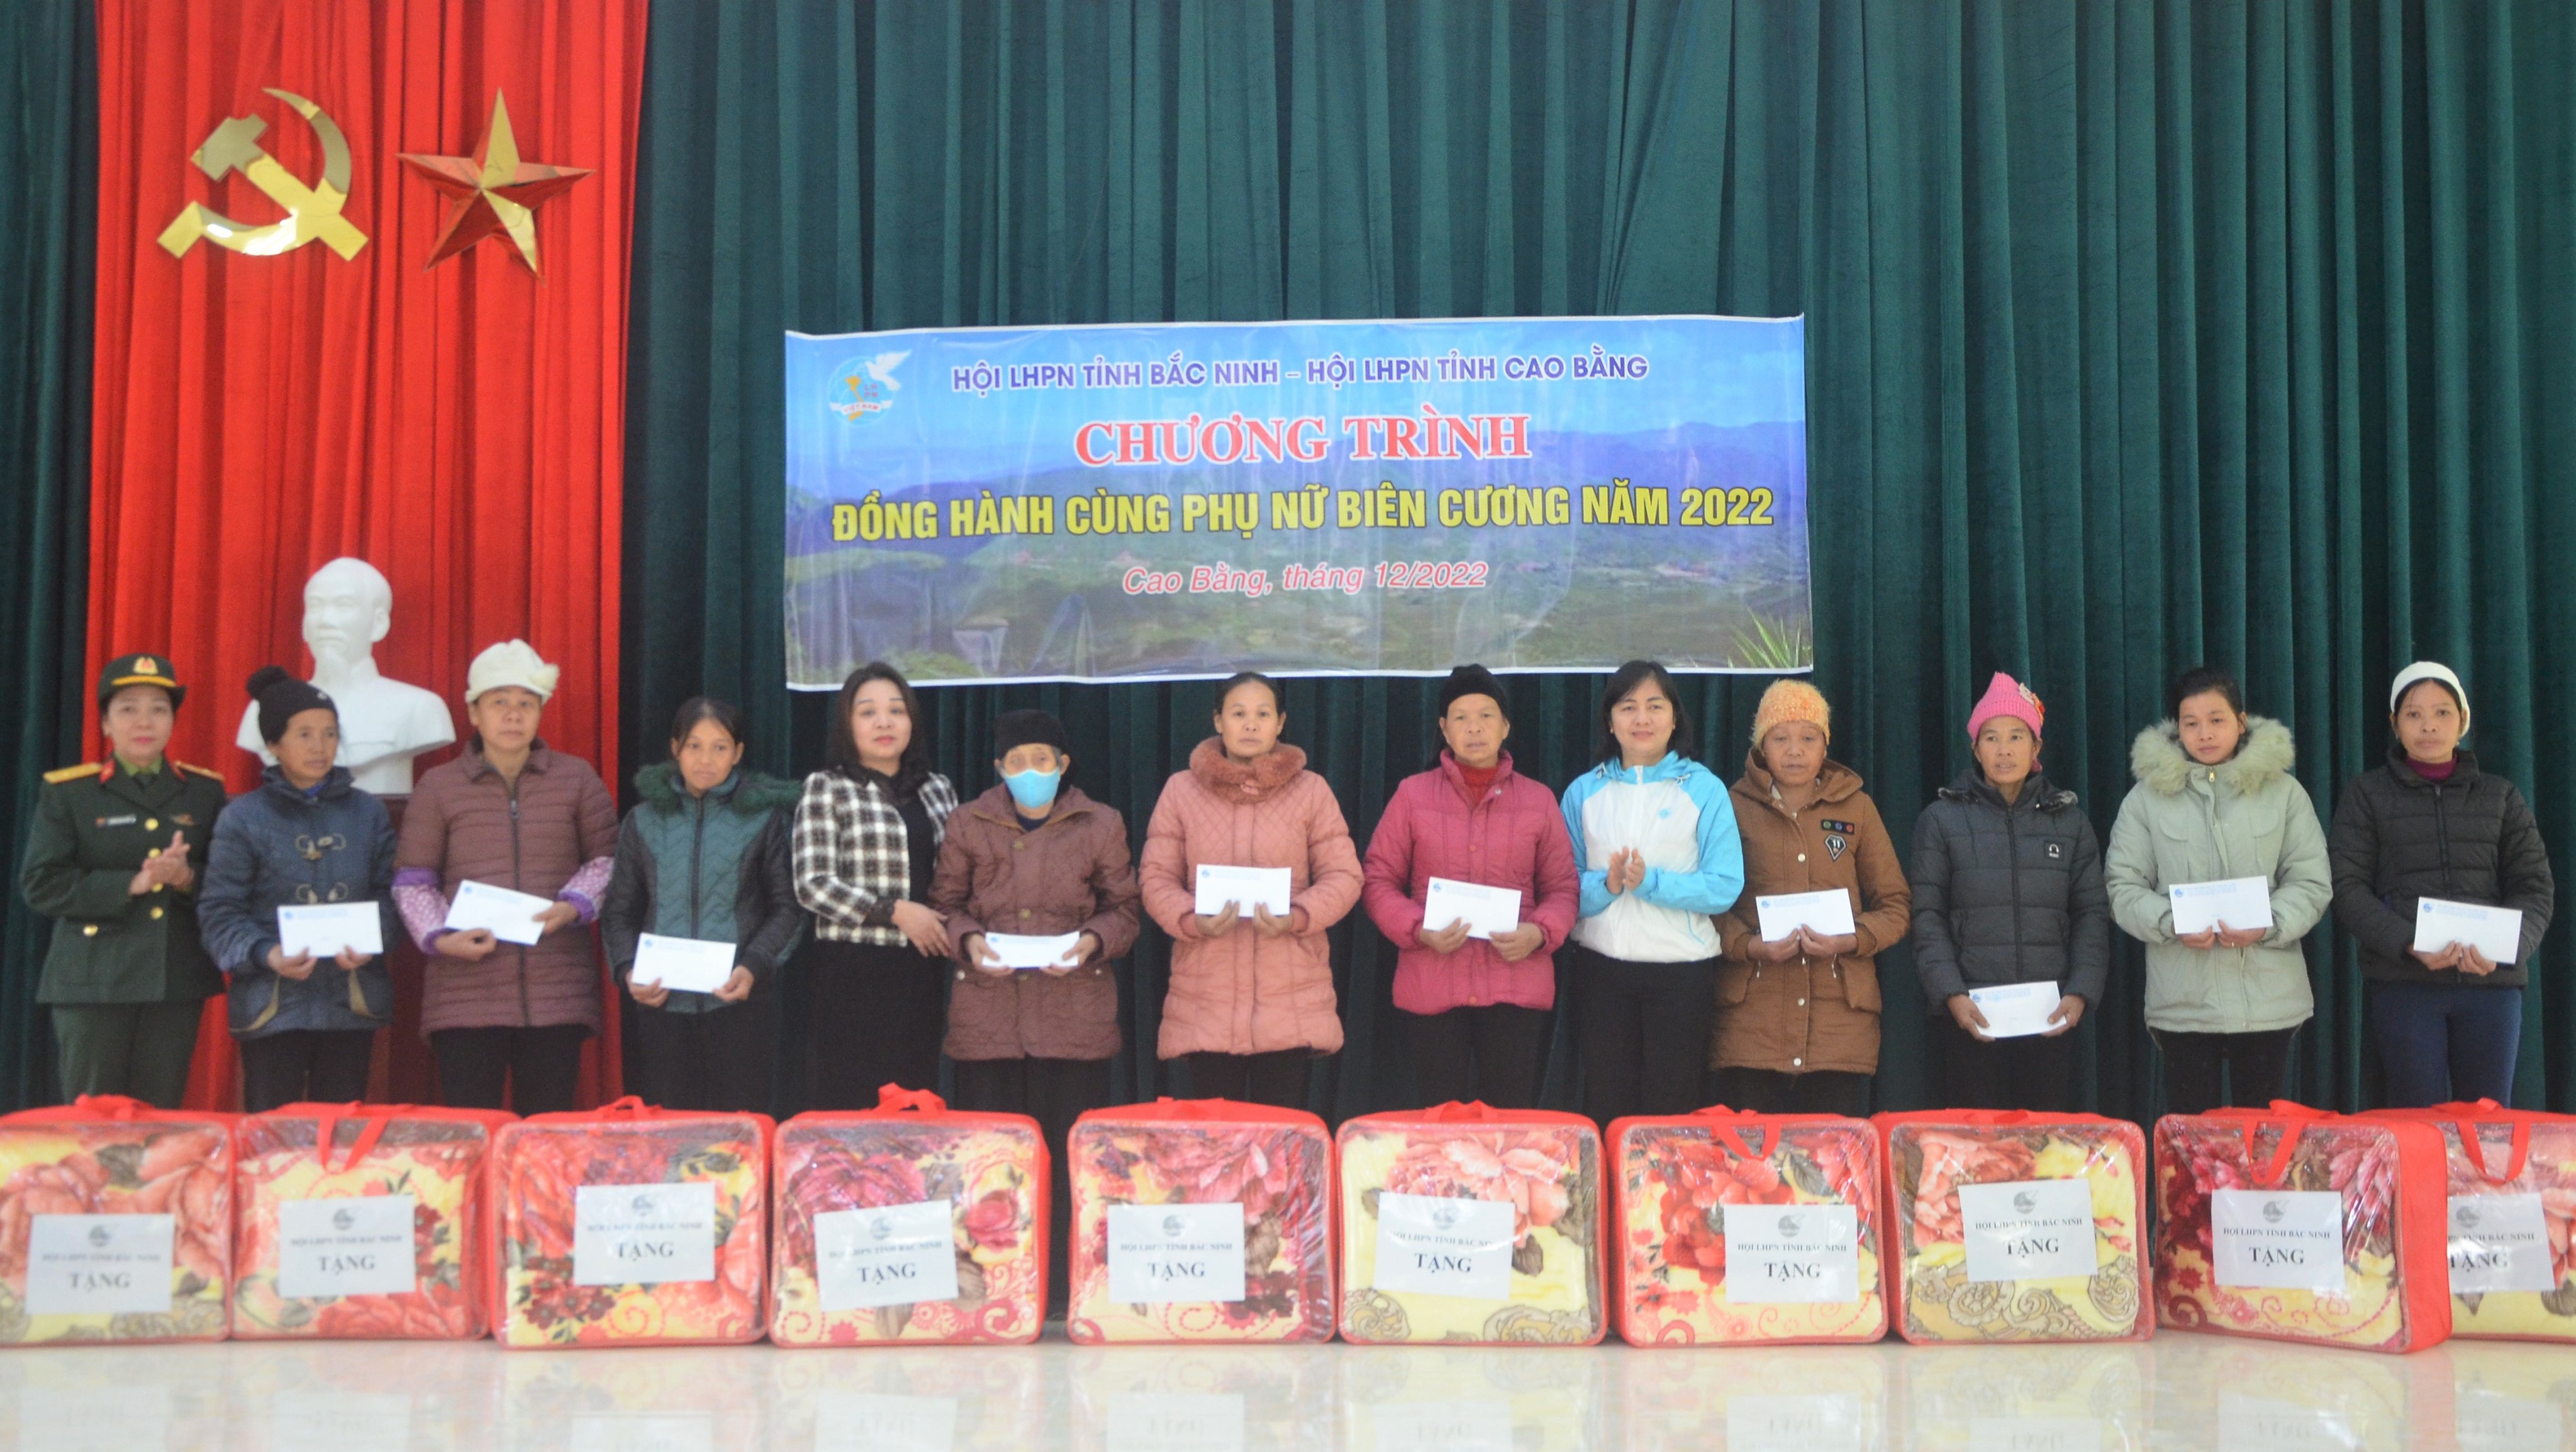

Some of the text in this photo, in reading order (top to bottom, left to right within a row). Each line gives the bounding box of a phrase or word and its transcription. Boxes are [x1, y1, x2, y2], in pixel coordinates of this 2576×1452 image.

[954, 361, 1000, 396] HỘI
[1010, 365, 1074, 388] LHPN
[1083, 357, 1140, 387] TỈNH
[1151, 352, 1205, 385] BẮC
[1215, 362, 1278, 384] NINH
[1308, 354, 1354, 388] HỘI
[1364, 360, 1428, 381] LHPN
[1437, 350, 1495, 380] TỈNH
[1505, 357, 1564, 380] CAO
[1573, 345, 1648, 379] BẰNG
[1076, 404, 1530, 465] CHƯƠNG TRÌNH
[832, 478, 1773, 541] ĐỒNG HÀNH CÙNG PHỤ NỮ BIÊN CƯƠNG NĂM 2022
[1124, 562, 1488, 596] Cao Bằng, tháng 12/2022
[2061, 1217, 2083, 1226] NINH
[2308, 1231, 2331, 1239] NINH
[2510, 1233, 2535, 1241] NINH
[615, 1240, 674, 1263] TẶNG
[2004, 1237, 2060, 1258] TẶNG
[2248, 1244, 2304, 1268] TẶNG
[318, 1253, 376, 1277] TẶNG
[857, 1261, 916, 1285] TẶNG
[1147, 1260, 1205, 1282] TẶNG
[1414, 1252, 1473, 1274] TẶNG
[1764, 1260, 1820, 1282] TẶNG
